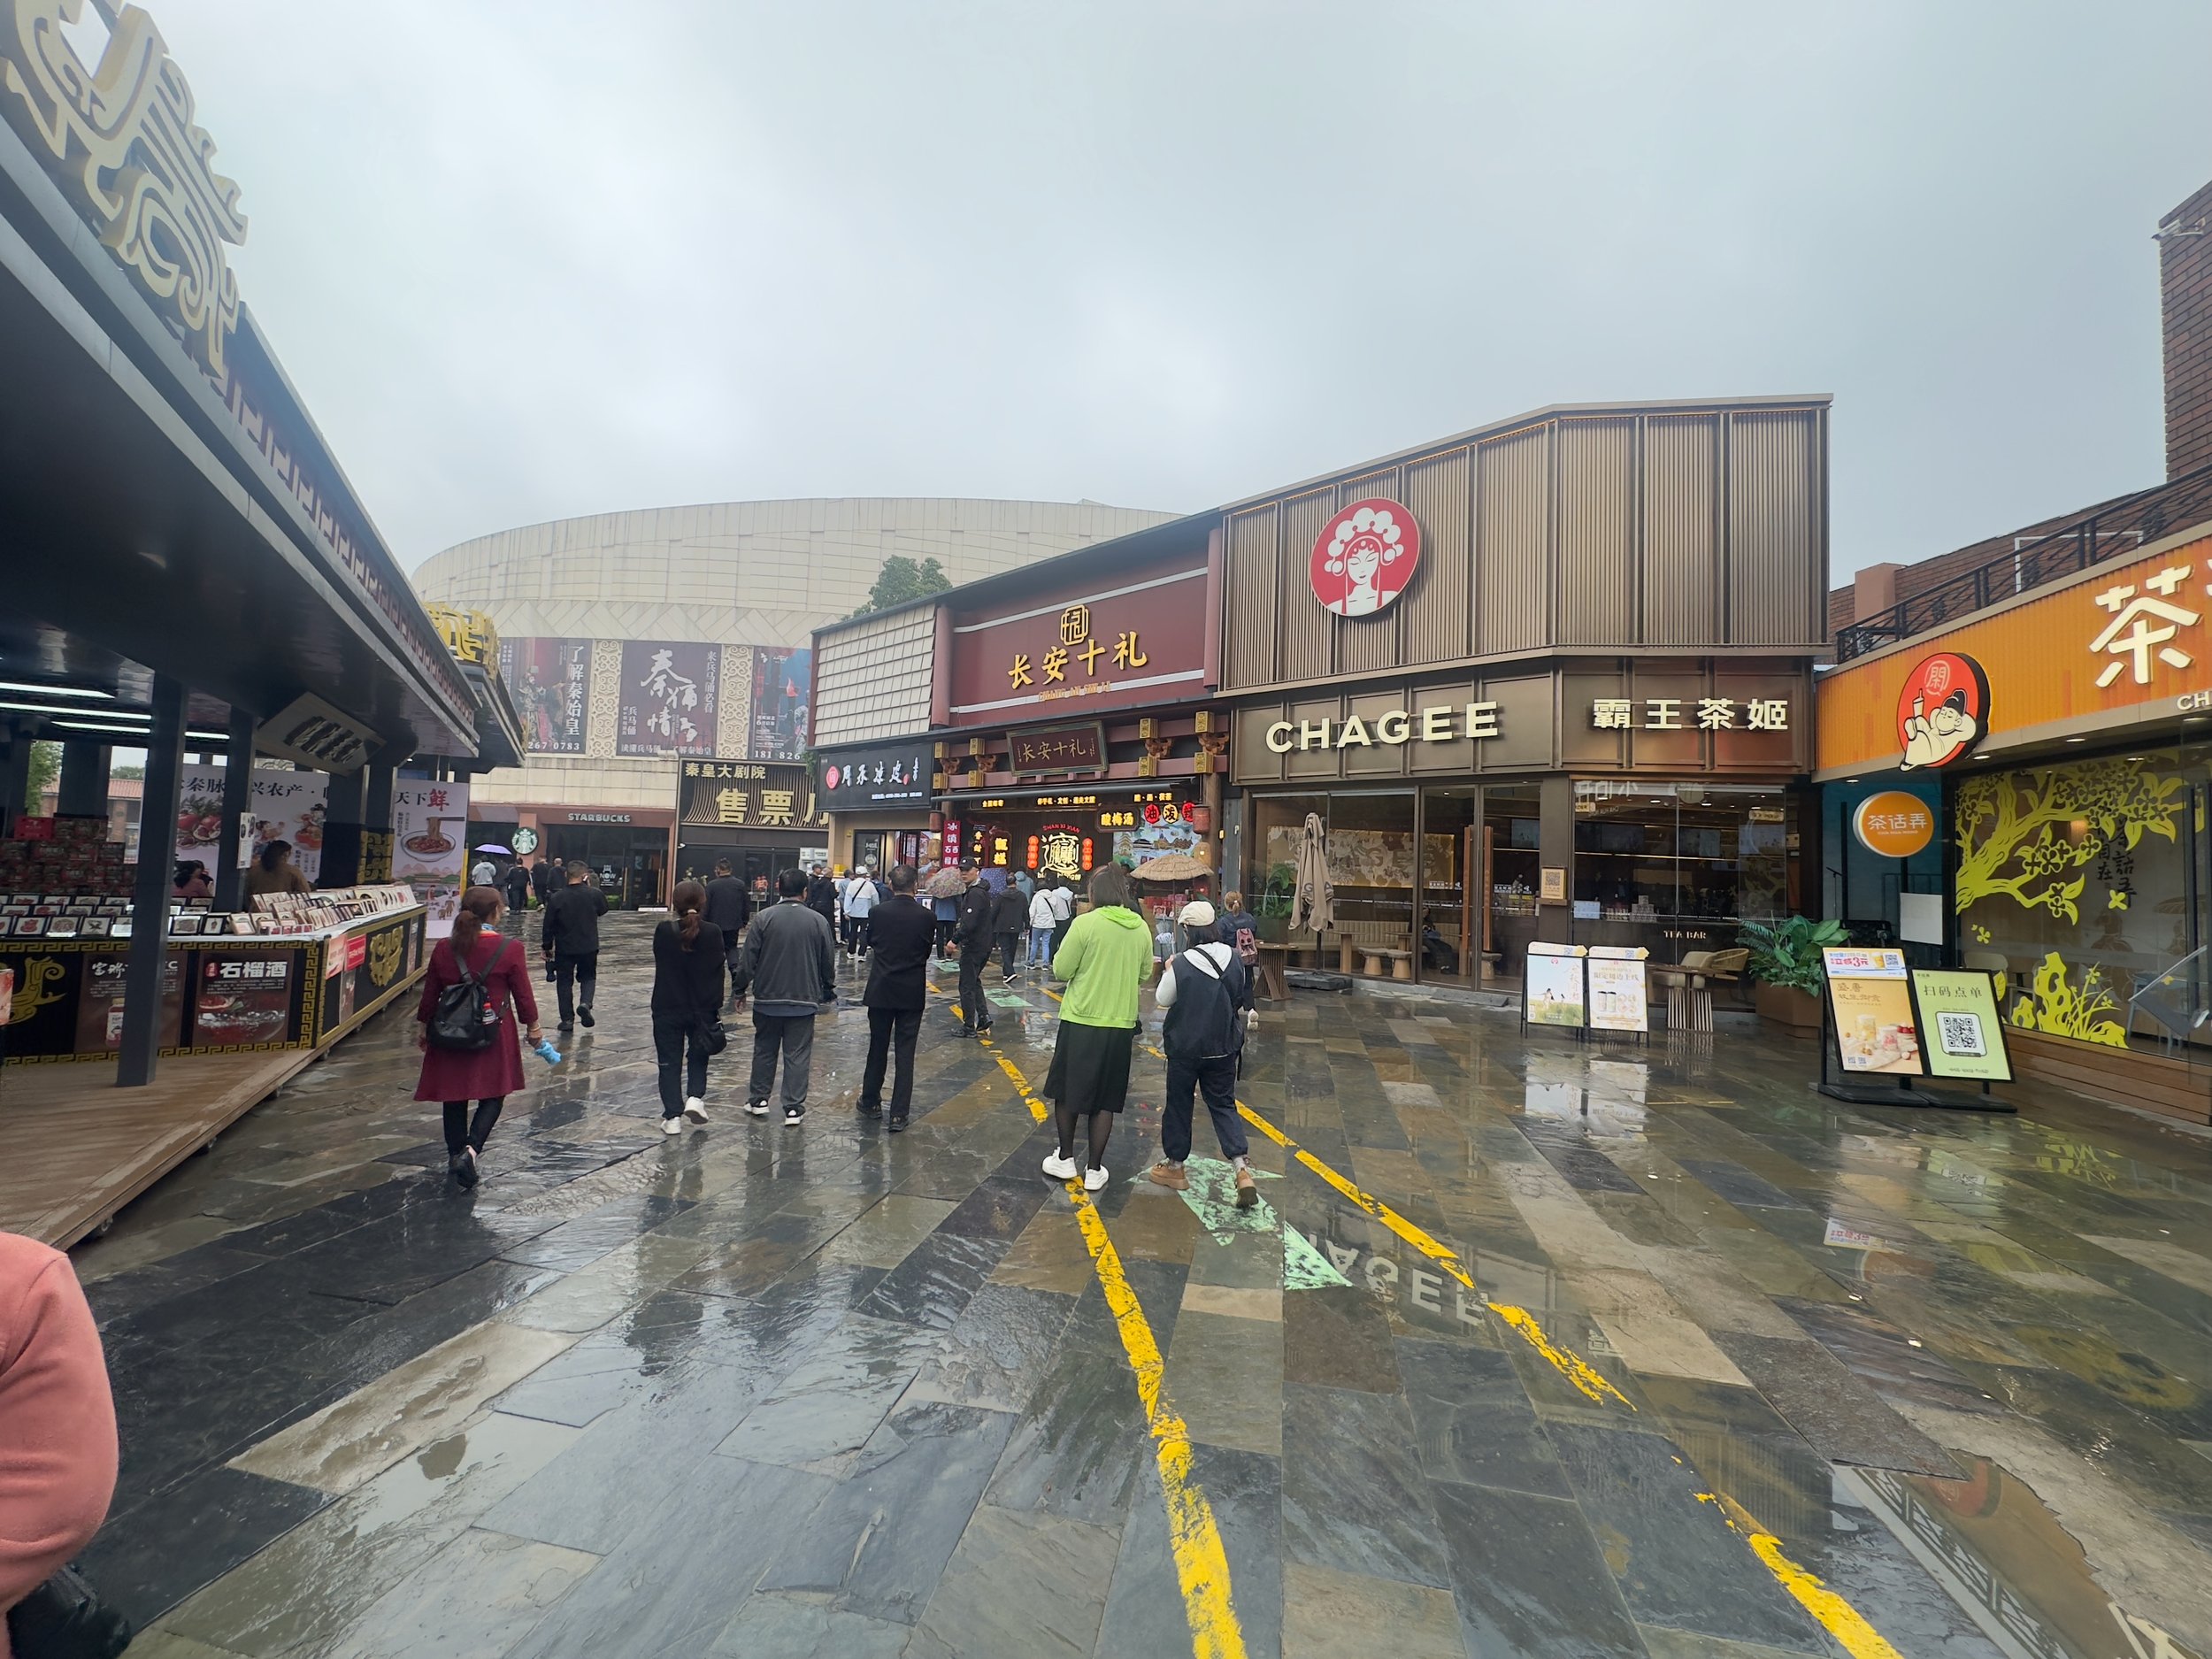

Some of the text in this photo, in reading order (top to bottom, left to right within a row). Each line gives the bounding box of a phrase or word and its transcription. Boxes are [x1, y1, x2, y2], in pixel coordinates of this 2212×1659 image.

[2089, 559, 2212, 687] 茶
[1008, 631, 1148, 689] 长安十礼
[565, 646, 584, 736] 了解秦始皇
[1594, 698, 1788, 730] 霸王茶姬
[1265, 701, 1498, 753] CHAGEE
[1023, 738, 1086, 763] 长安十礼
[686, 763, 766, 780] 秦皇大剧院
[396, 788, 449, 811] 天下鲜
[568, 813, 630, 823] STARBUCKS
[1101, 812, 1133, 826] 酸梅汤
[1868, 813, 1927, 830] 茶话弄
[1686, 931, 1707, 940] BAR
[220, 961, 288, 979] 石榴酒
[1924, 985, 1982, 998] 扫码点单
